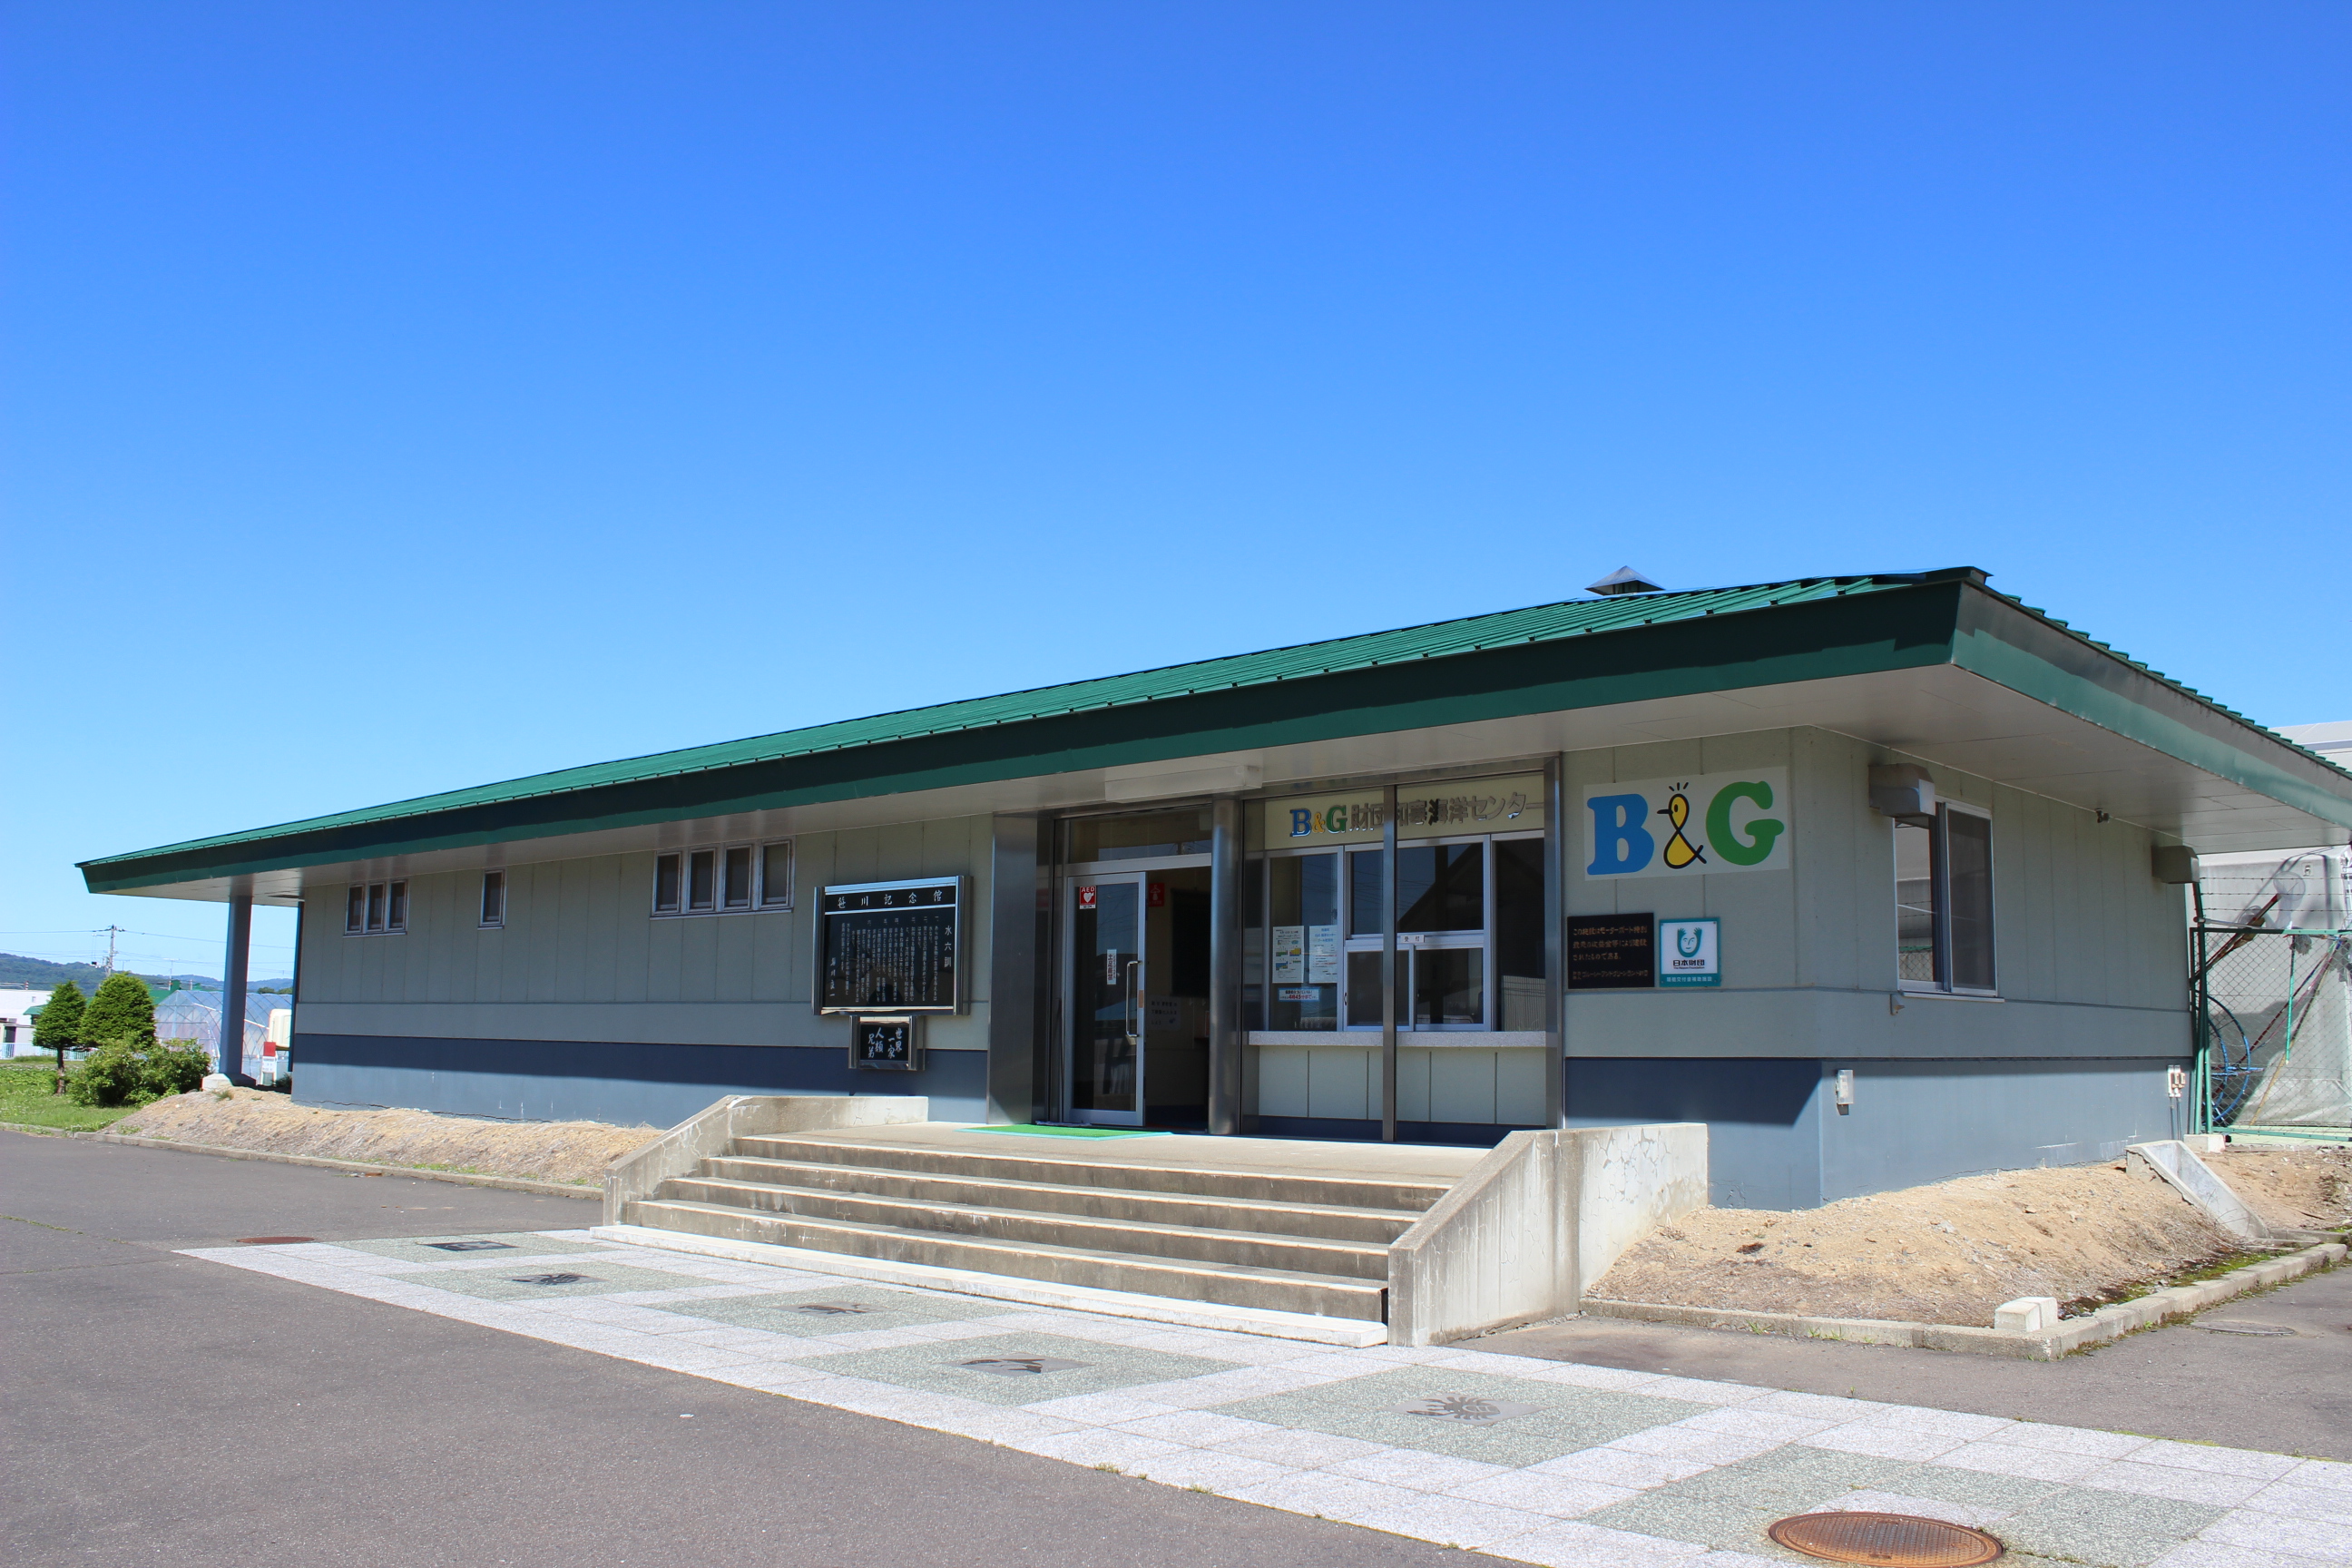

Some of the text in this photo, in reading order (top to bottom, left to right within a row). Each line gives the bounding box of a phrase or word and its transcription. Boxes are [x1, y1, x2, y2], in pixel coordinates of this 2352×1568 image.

[1586, 780, 1785, 876] B&G
[838, 890, 943, 909] 笹川記念館
